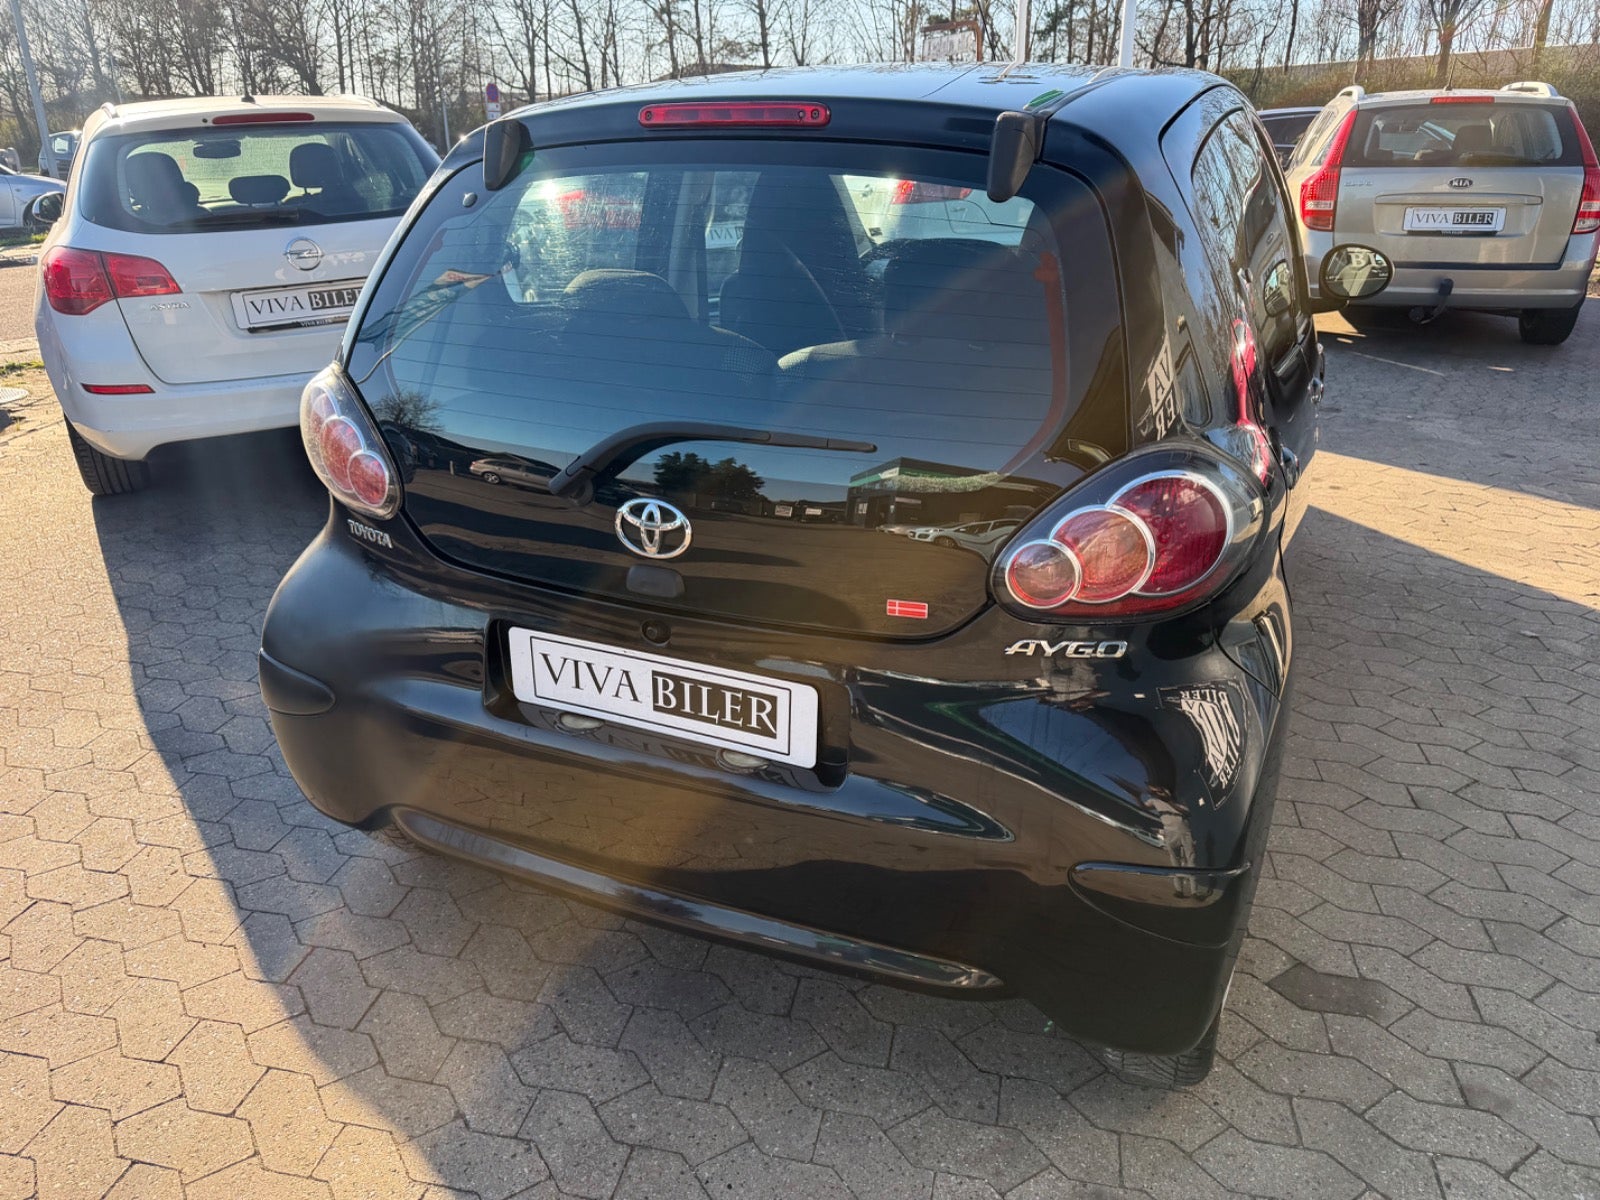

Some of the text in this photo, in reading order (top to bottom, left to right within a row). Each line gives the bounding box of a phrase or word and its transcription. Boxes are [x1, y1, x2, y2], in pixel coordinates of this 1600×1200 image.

[1451, 178, 1470, 188] KIA
[1415, 213, 1494, 224] VIVA BILER
[250, 296, 305, 315] VIVA
[347, 519, 393, 549] TOYOTA
[1005, 639, 1127, 659] AYGO
[538, 652, 777, 734] VIVA BILER
